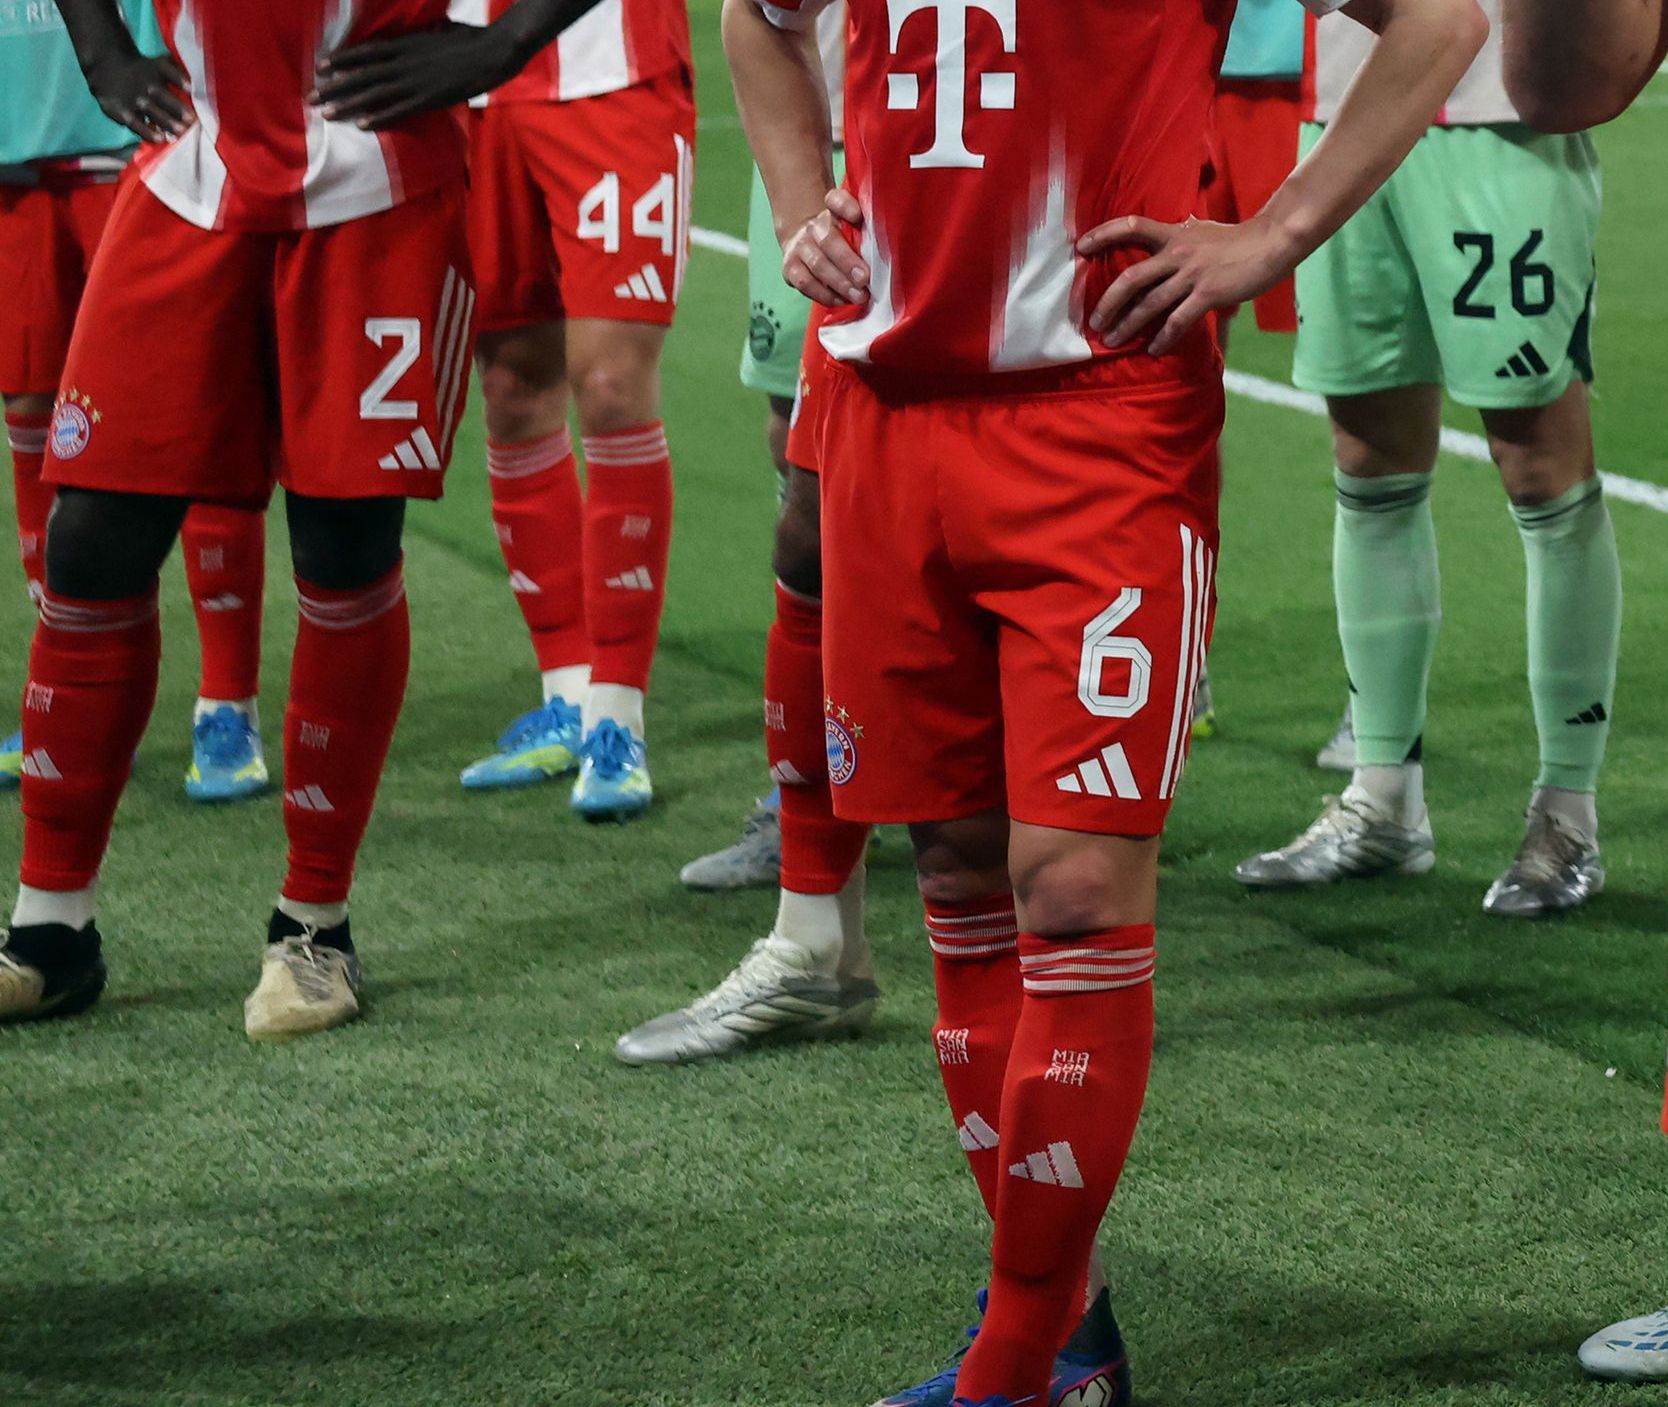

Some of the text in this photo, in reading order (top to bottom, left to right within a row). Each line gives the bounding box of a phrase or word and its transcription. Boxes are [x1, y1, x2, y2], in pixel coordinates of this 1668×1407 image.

[577, 173, 676, 256] 44
[1452, 228, 1555, 320] 26
[359, 317, 421, 420] 2
[1077, 586, 1152, 719] 6
[938, 1038, 968, 1053] SAN
[941, 1051, 970, 1065] MIA
[1051, 1048, 1090, 1065] MIA
[1044, 1066, 1084, 1087] MIA
